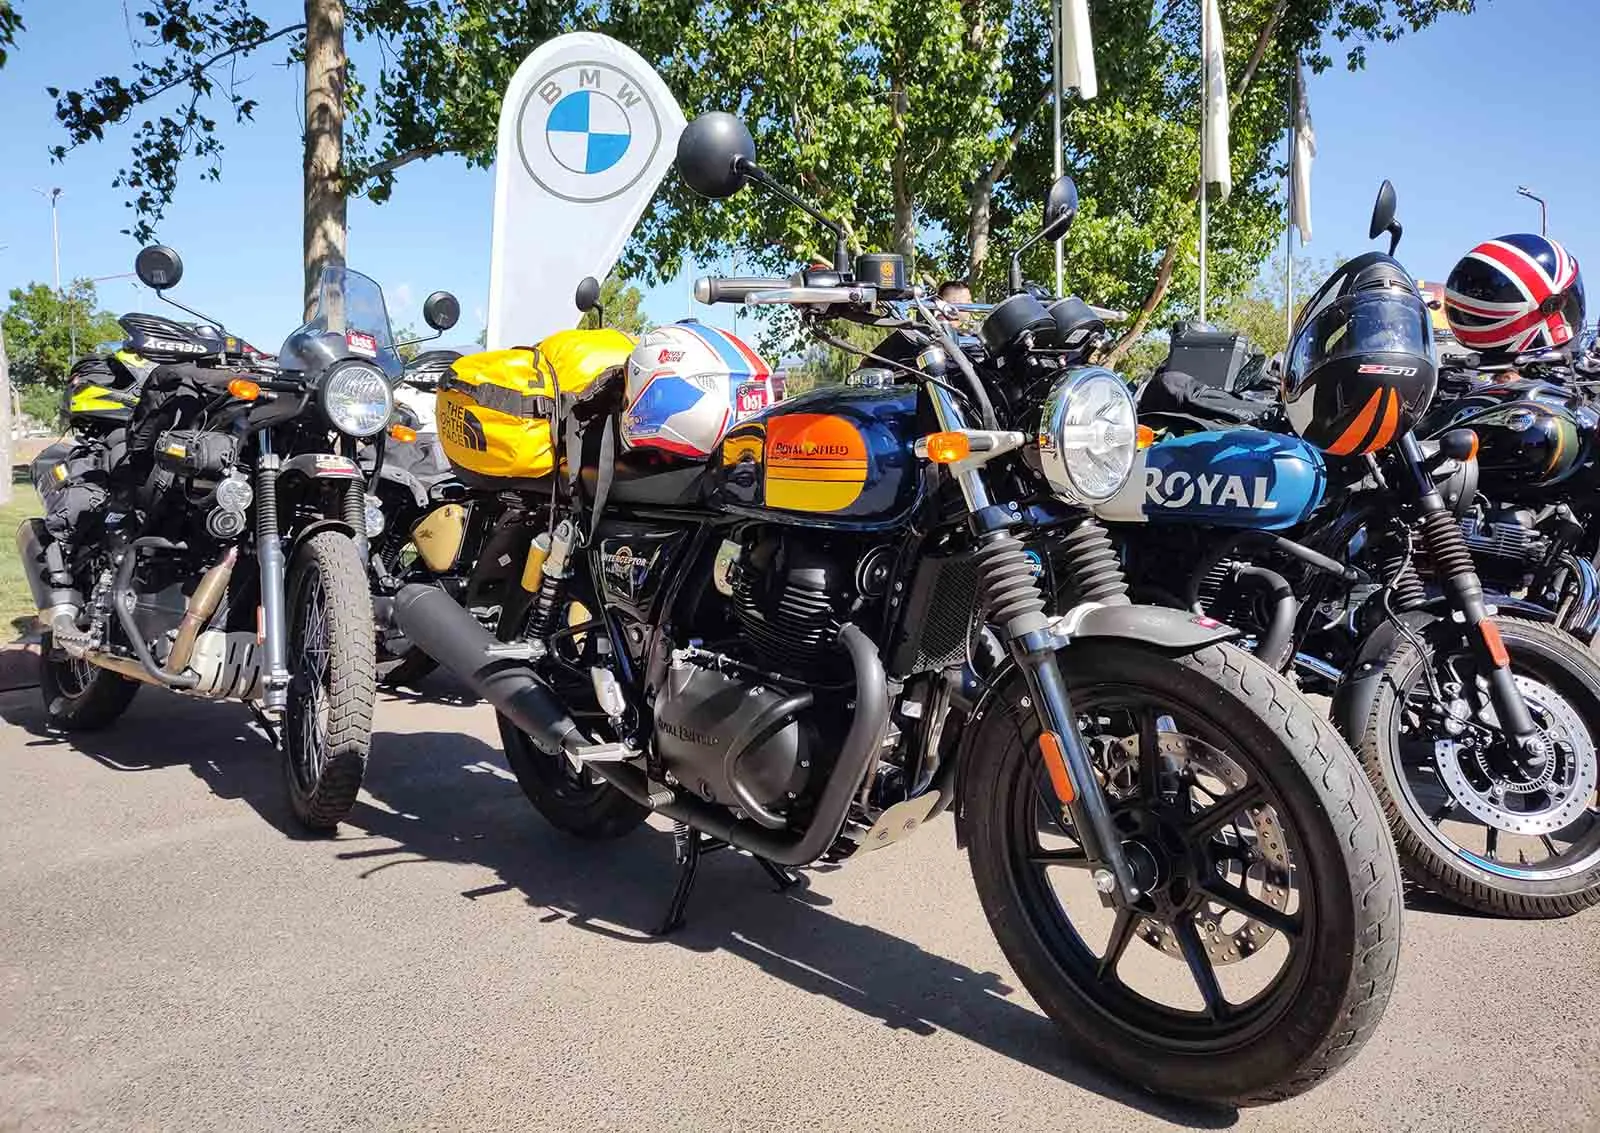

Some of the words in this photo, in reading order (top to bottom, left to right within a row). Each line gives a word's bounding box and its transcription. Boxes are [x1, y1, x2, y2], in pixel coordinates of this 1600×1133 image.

[538, 69, 642, 108] BMW
[446, 401, 464, 420] THE
[1142, 466, 1278, 509] ROYAL
